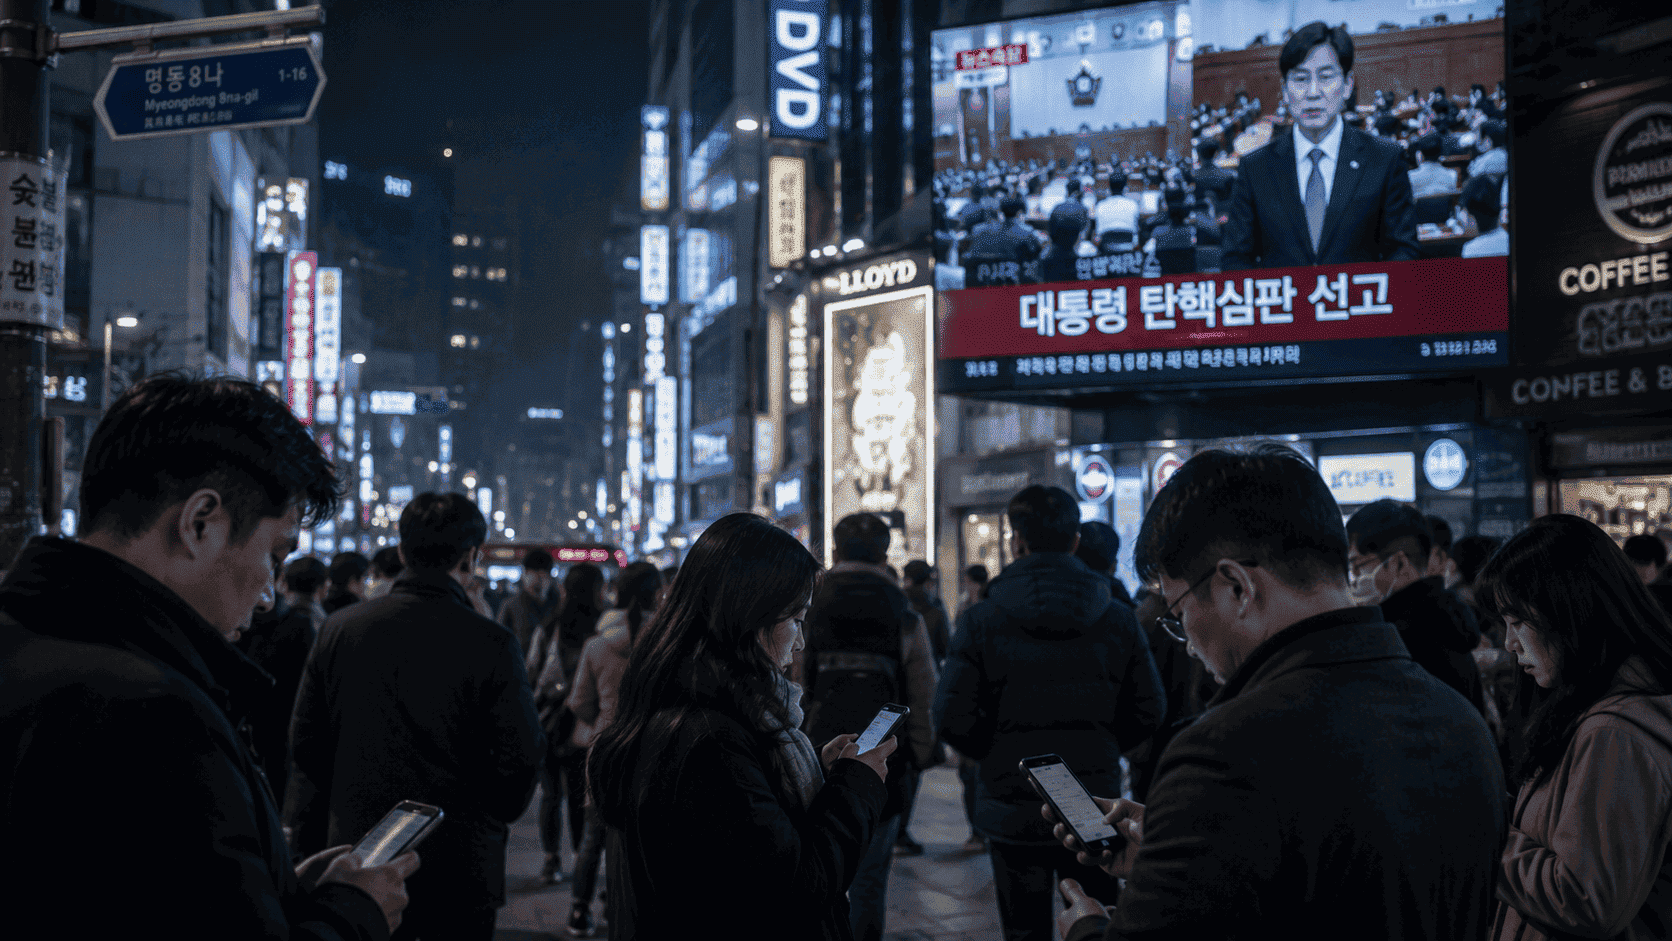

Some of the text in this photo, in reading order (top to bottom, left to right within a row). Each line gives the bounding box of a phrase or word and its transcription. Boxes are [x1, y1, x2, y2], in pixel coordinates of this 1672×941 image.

[145, 62, 224, 94] 명동8나
[278, 67, 308, 82] 1-16
[146, 96, 216, 113] Myeongdong
[838, 258, 918, 296] LLOYD
[1559, 252, 1670, 295] COFFEE
[1018, 271, 1394, 338] 대통령 탄핵심판 선고
[1628, 367, 1648, 392] &
